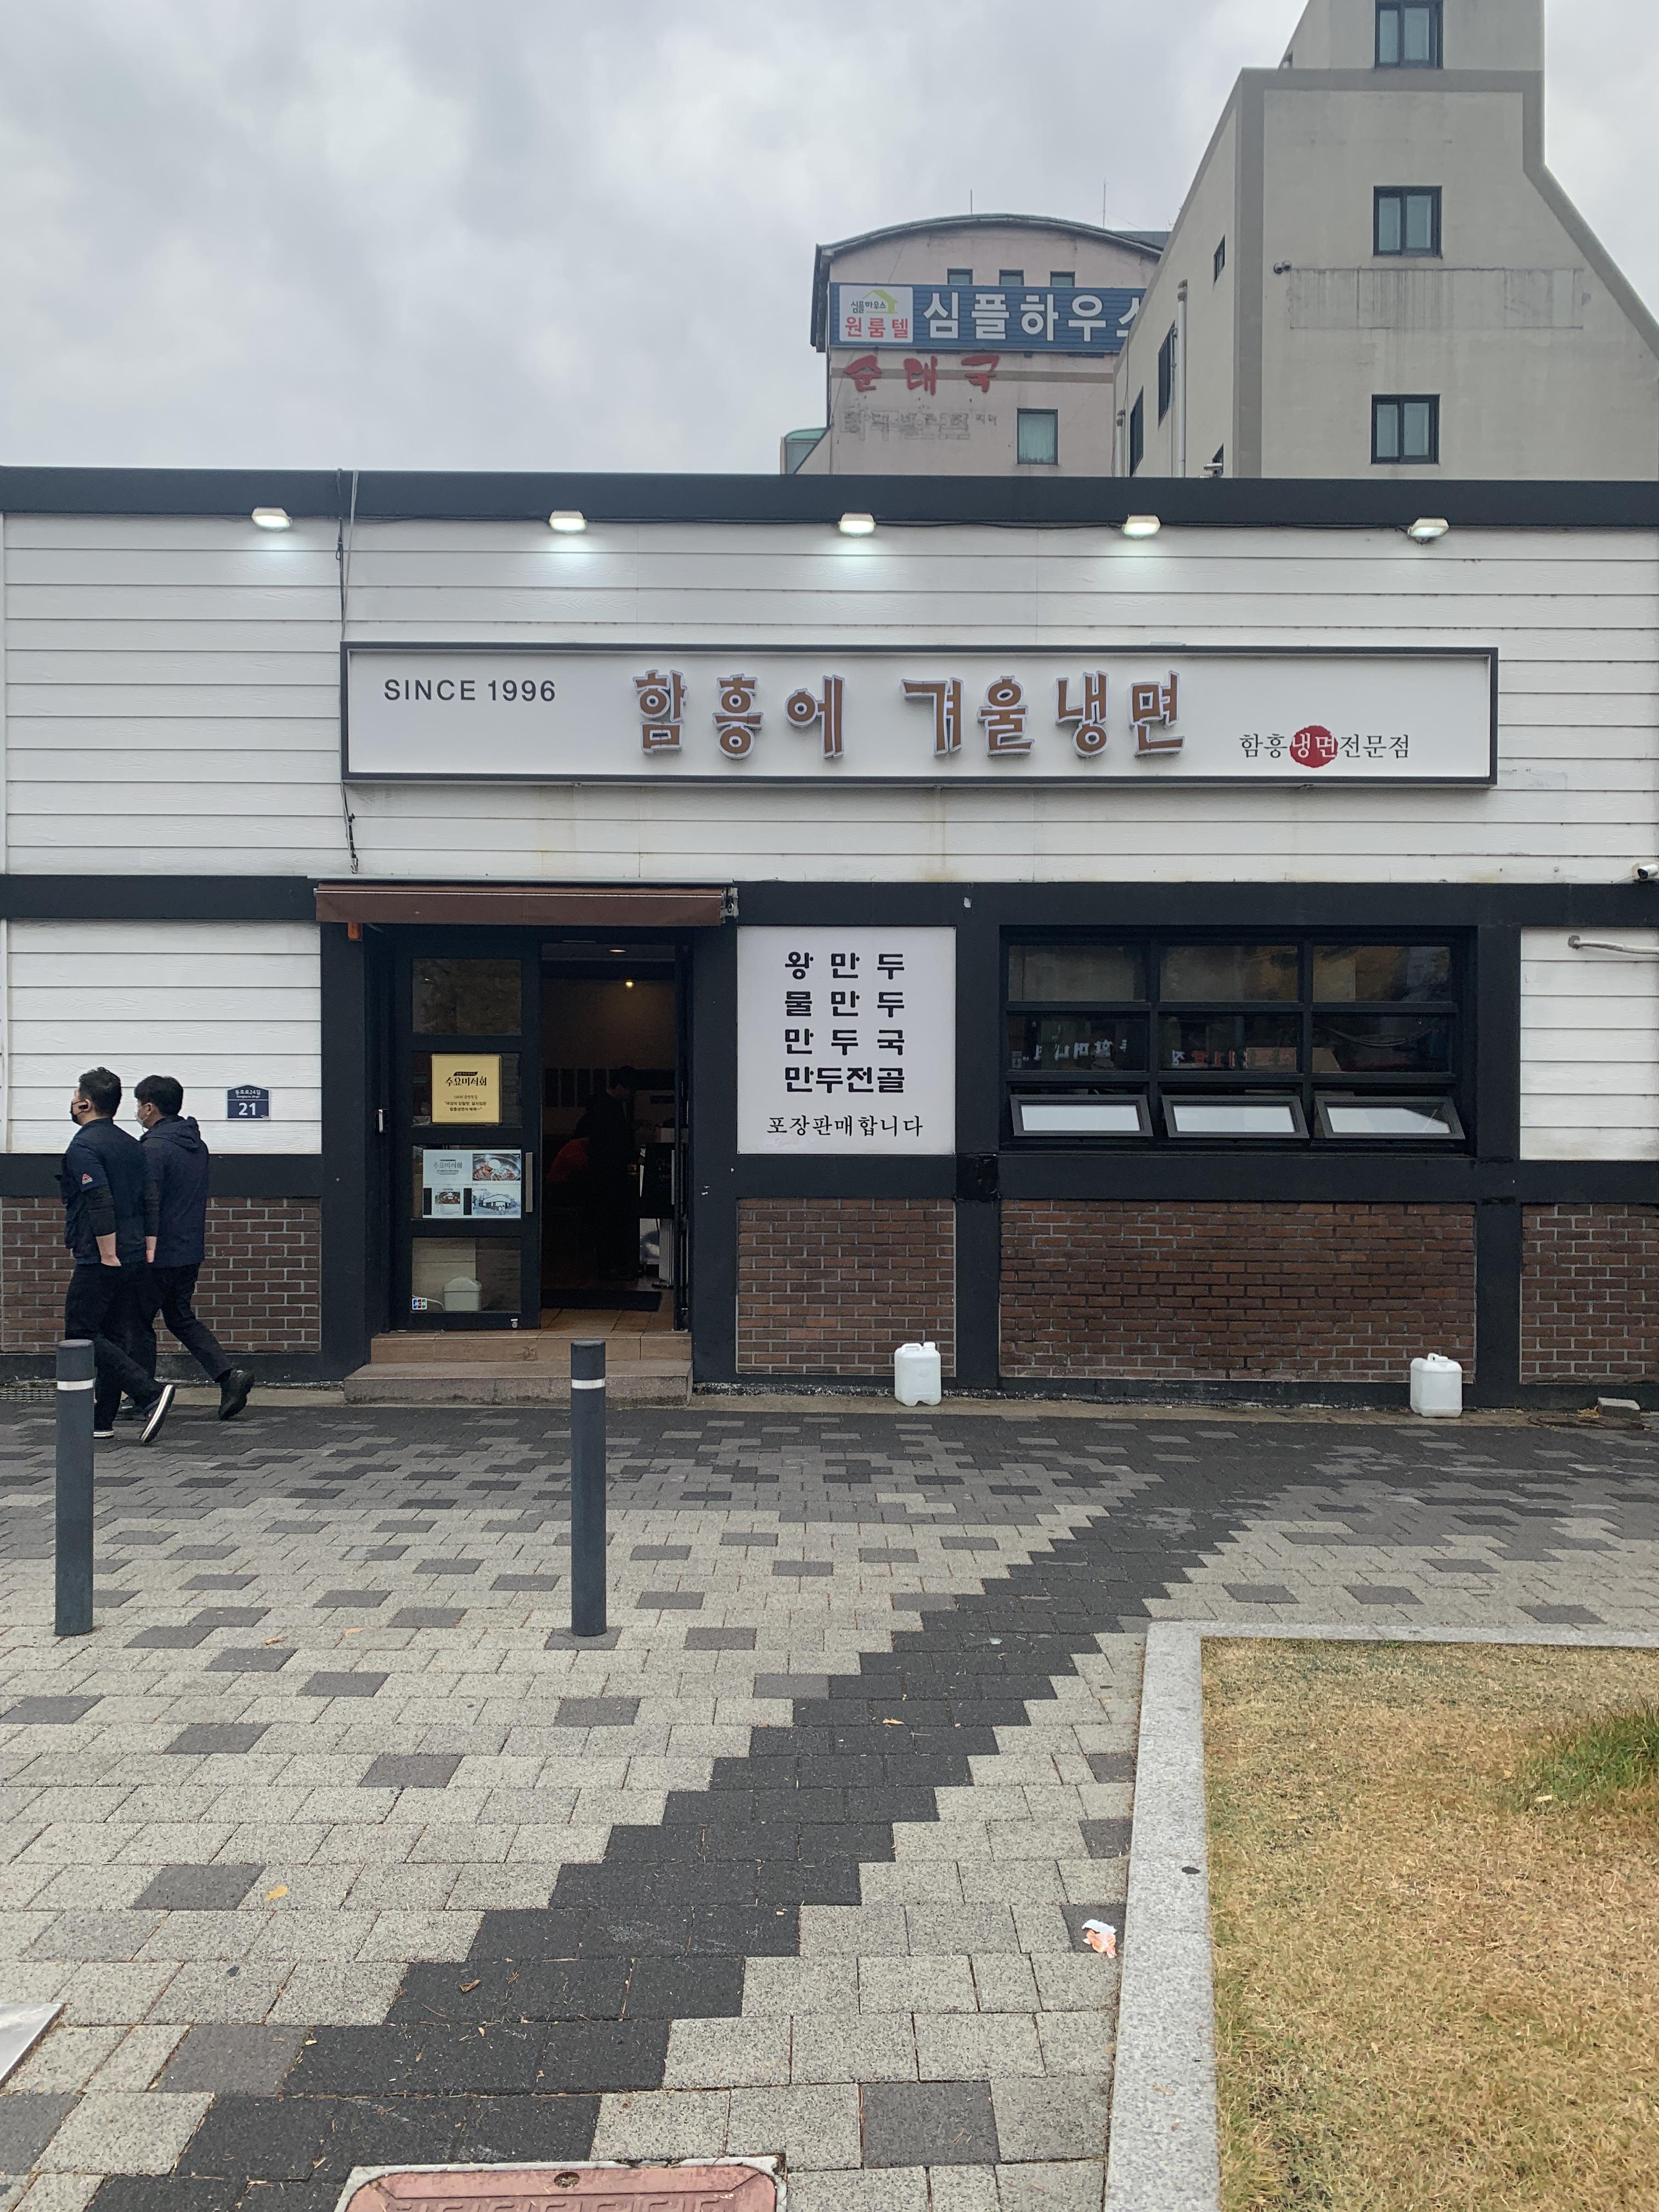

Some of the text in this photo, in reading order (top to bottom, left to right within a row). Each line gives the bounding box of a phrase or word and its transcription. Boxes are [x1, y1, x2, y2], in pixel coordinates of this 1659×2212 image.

[850, 300, 887, 314] 심플하우스
[845, 316, 909, 338] 원룸텔
[384, 679, 556, 702] SINCE 1996
[633, 669, 1186, 760] 함흥에 겨울냉면
[785, 1066, 905, 1093] 만두전골
[238, 1102, 256, 1116] 21
[767, 1115, 923, 1137] 포장판매합니다
